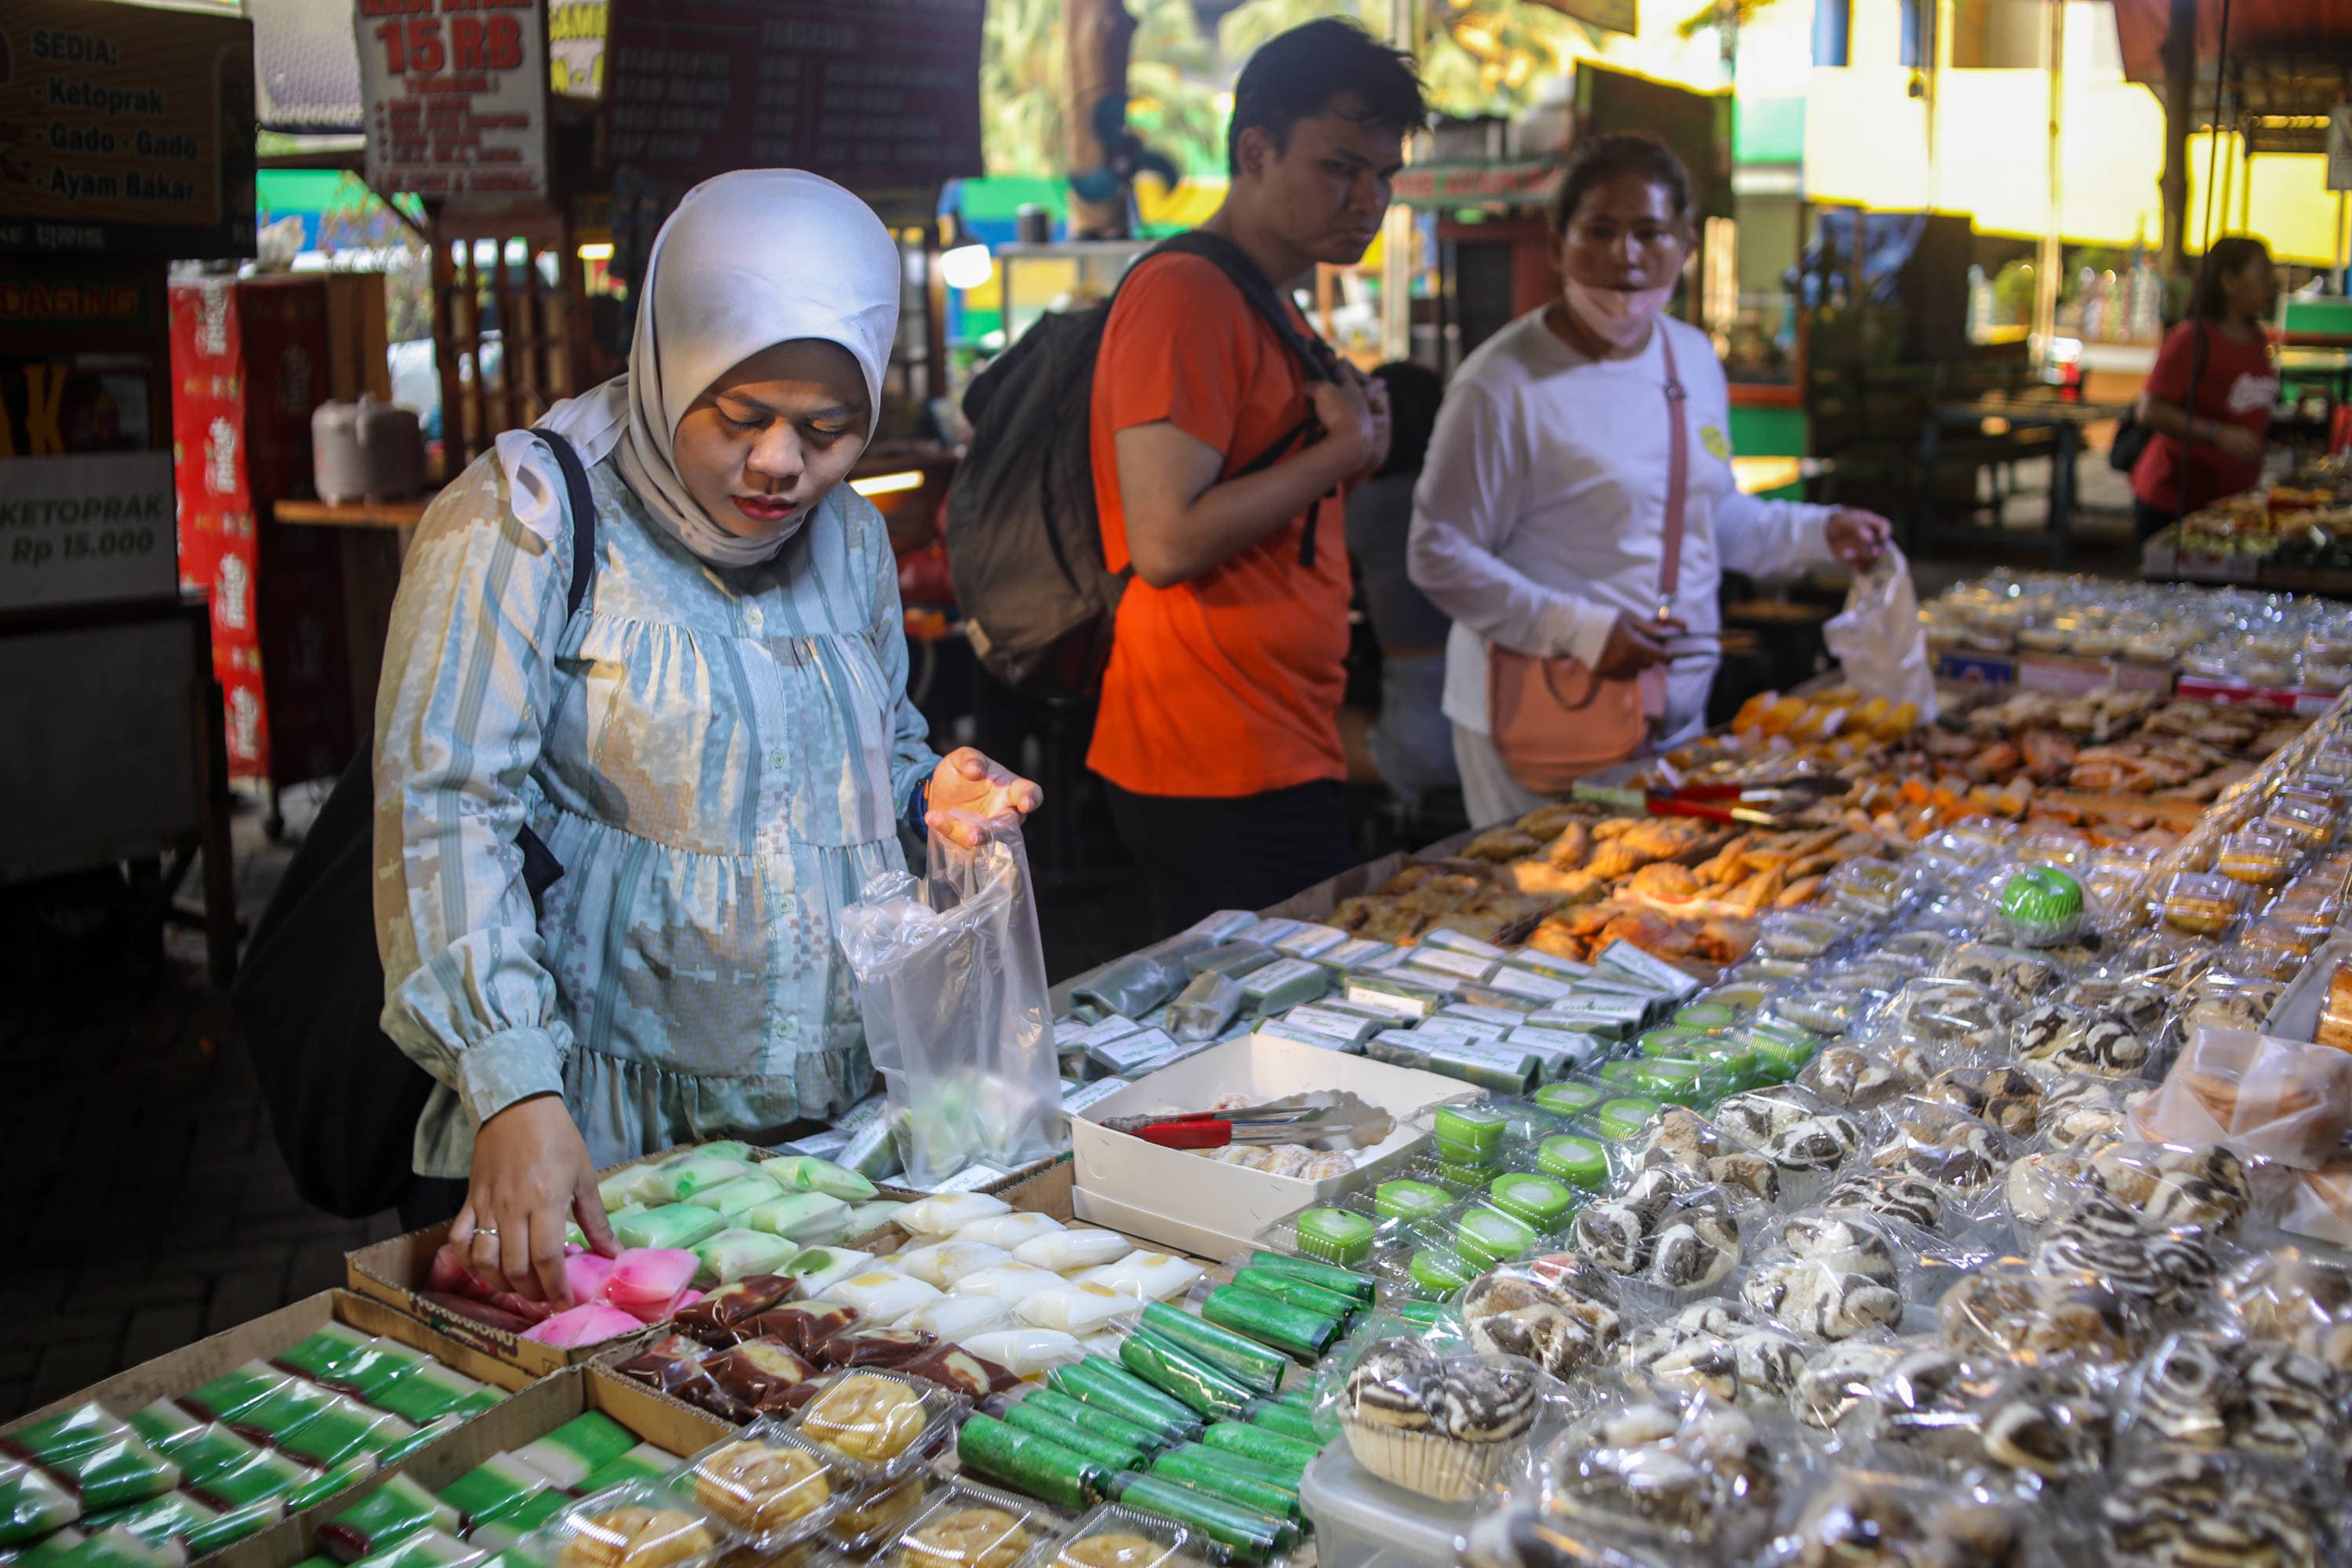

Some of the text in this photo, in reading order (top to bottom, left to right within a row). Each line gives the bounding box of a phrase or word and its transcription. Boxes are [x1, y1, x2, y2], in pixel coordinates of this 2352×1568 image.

[33, 29, 118, 66] SEDIA:
[376, 19, 445, 74] 15
[451, 15, 523, 71] RB
[49, 74, 163, 115] Ketoprak
[49, 120, 199, 160] Gado Gado
[49, 165, 197, 202] Ayam Bakar
[0, 494, 162, 527] KETOPRAK
[10, 526, 154, 566] Rp 15.000
